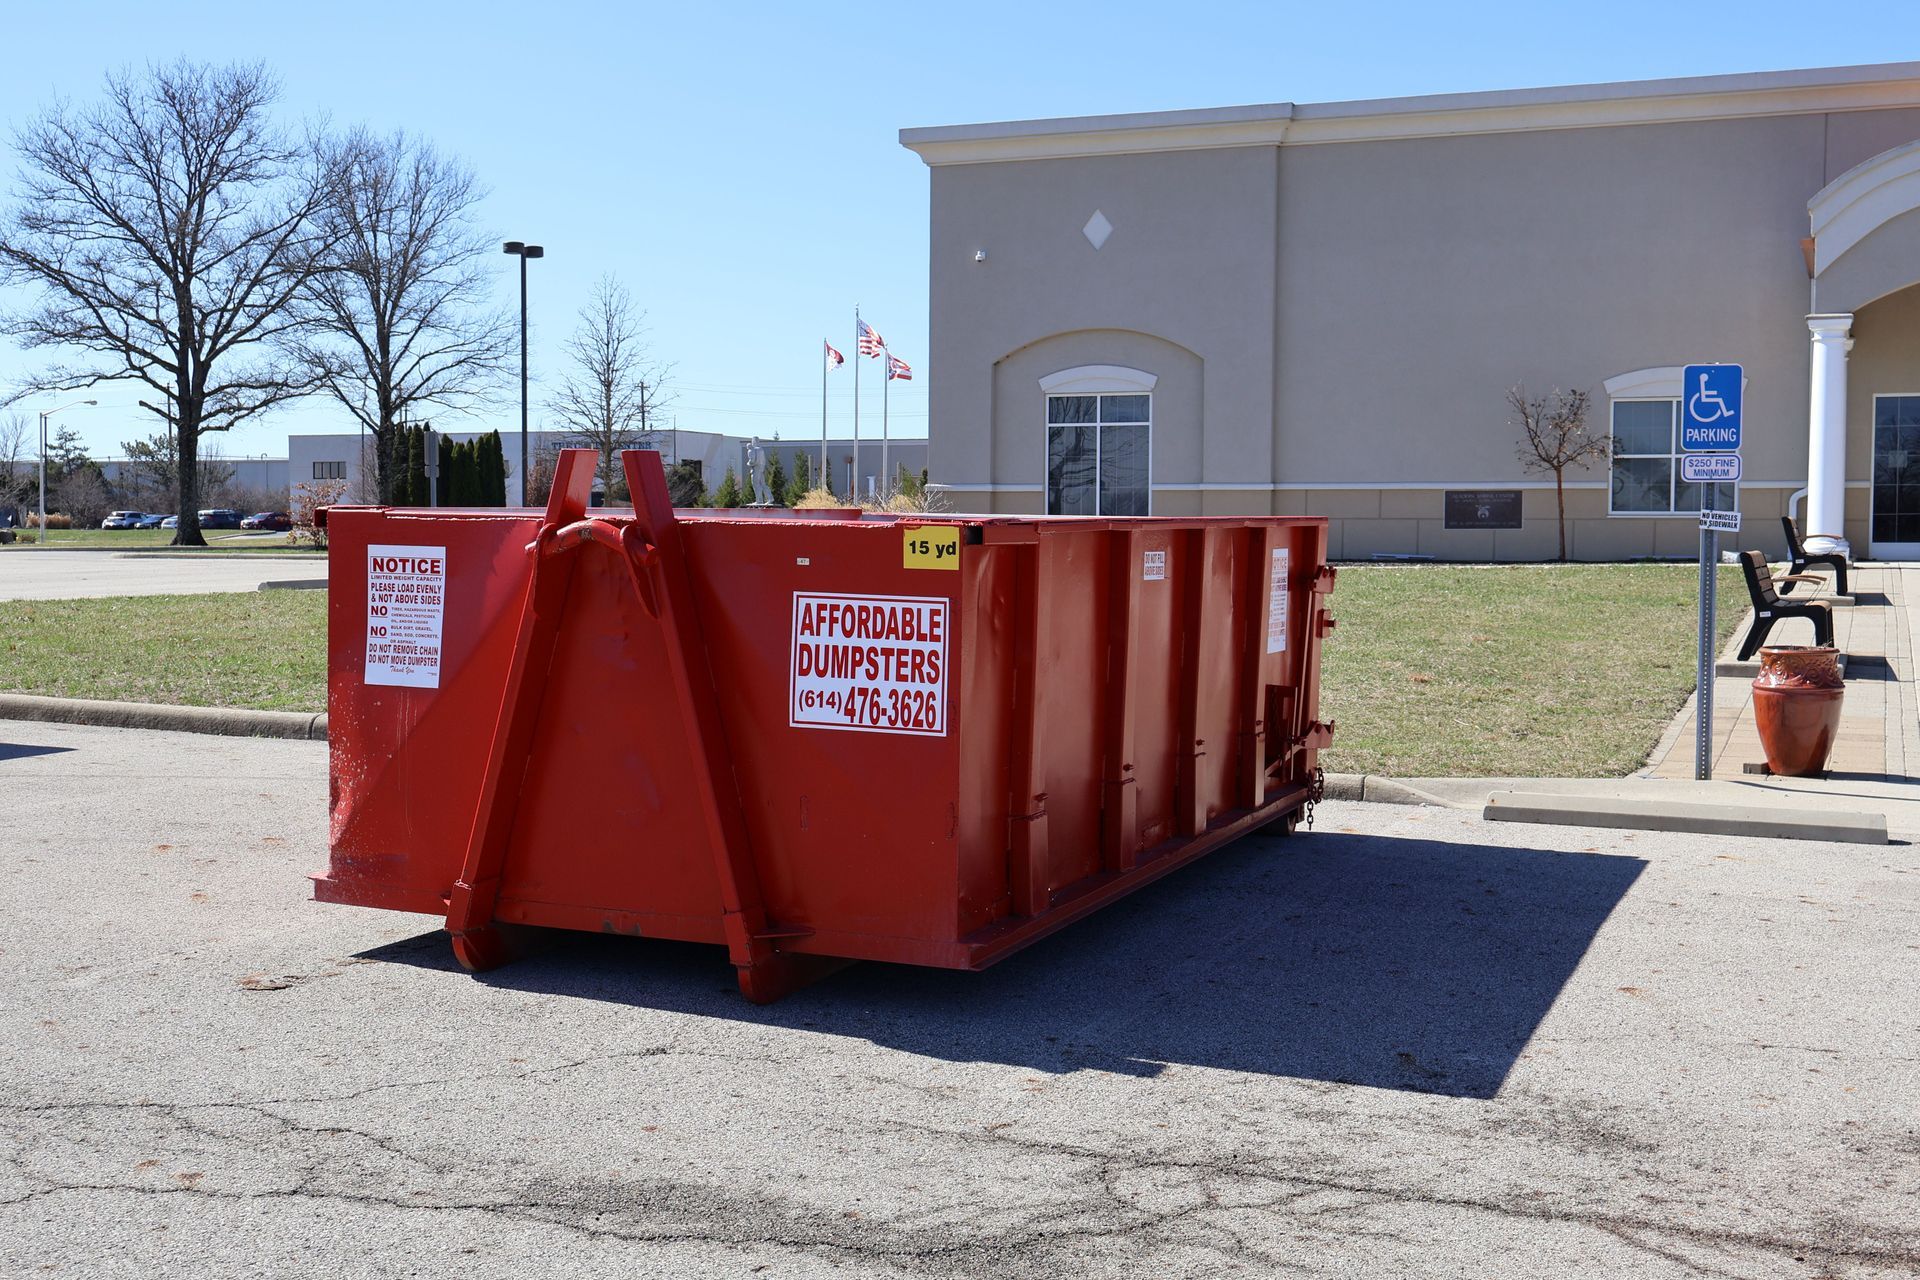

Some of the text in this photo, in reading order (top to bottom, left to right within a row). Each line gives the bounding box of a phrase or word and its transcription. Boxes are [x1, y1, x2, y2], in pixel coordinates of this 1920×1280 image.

[1686, 428, 1737, 442] PARKING
[1688, 459, 1735, 468] $250 FINE
[1693, 469, 1730, 477] MINIMUM
[1711, 513, 1738, 521] VEHICLES
[1708, 520, 1738, 529] SIDEWALK
[909, 540, 957, 559] 15 yd
[372, 557, 441, 574] NOTICE
[370, 582, 442, 594] PLEASE LOAD EVENLY
[370, 593, 441, 605] & NOT ABOVE SIDES
[370, 605, 388, 616] NO
[799, 602, 942, 643] AFFORDABLE
[370, 626, 387, 637] NO
[368, 643, 438, 656] DO NOT REMOVE CHAIN
[368, 654, 438, 667] DO NOT MOVE DUMPSTER
[798, 643, 941, 685] DUMPSTERS
[390, 665, 415, 675] Thank You
[799, 686, 937, 729] (614) 476-3626
